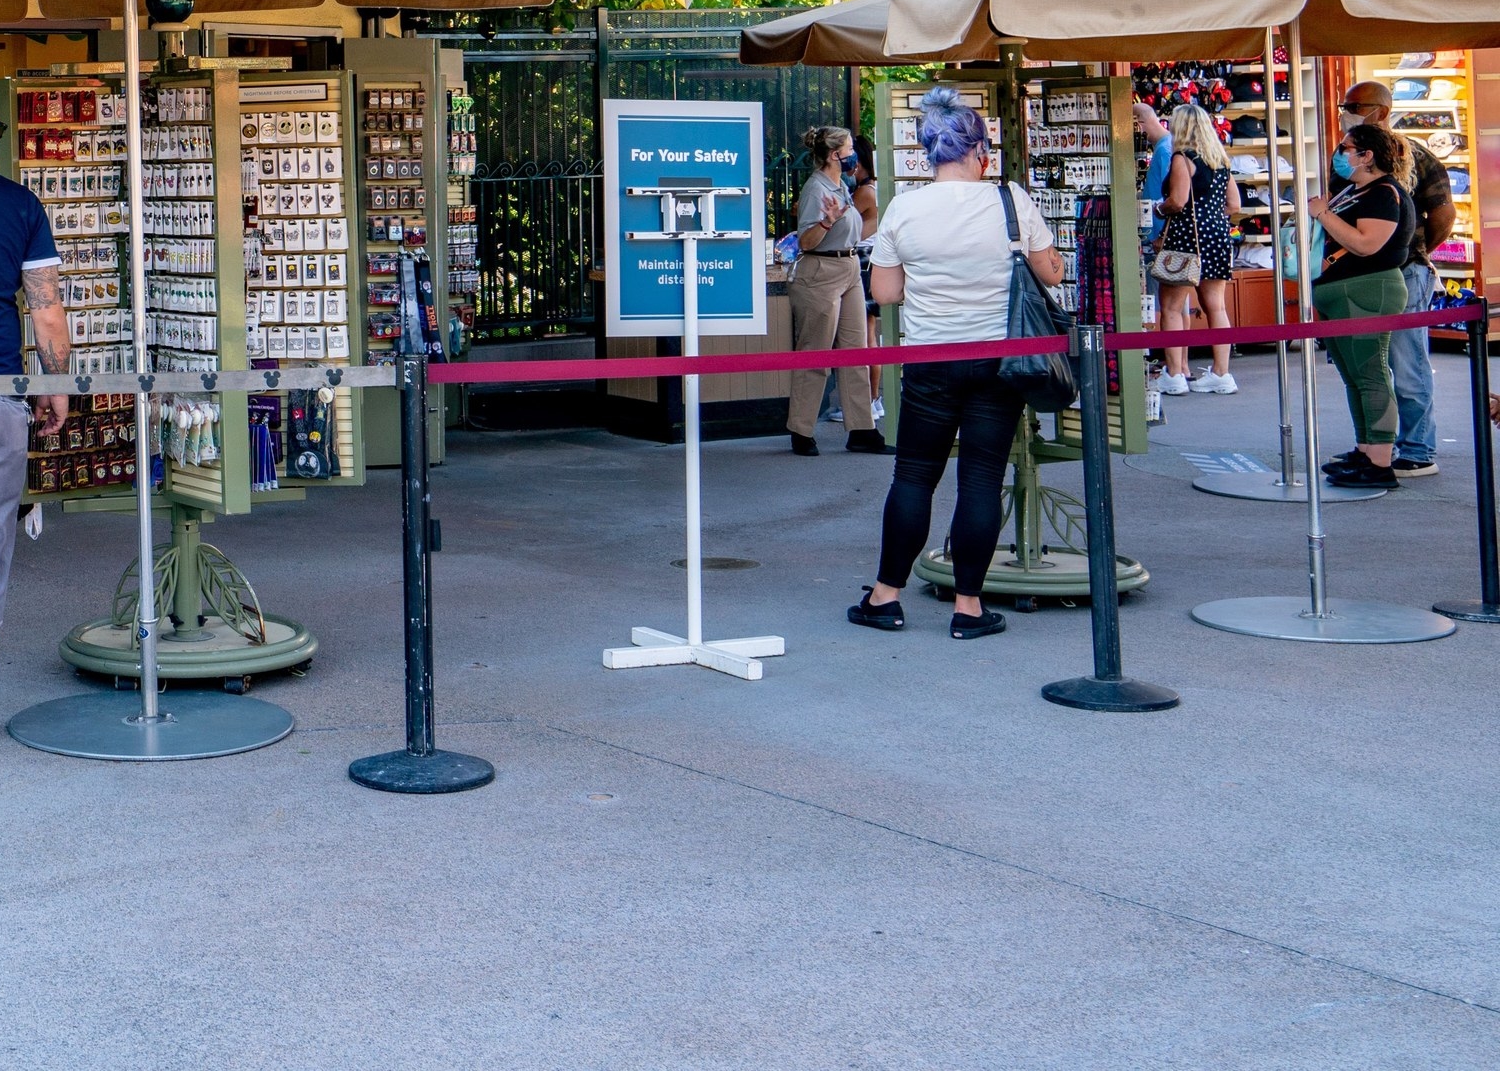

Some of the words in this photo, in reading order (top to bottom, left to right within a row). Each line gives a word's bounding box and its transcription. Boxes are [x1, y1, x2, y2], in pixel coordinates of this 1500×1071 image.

[631, 148, 654, 163] For
[657, 149, 690, 163] Your
[694, 149, 738, 166] Safety
[638, 259, 685, 270] Maintain
[696, 259, 733, 272] hysical
[658, 274, 715, 286] distaing
